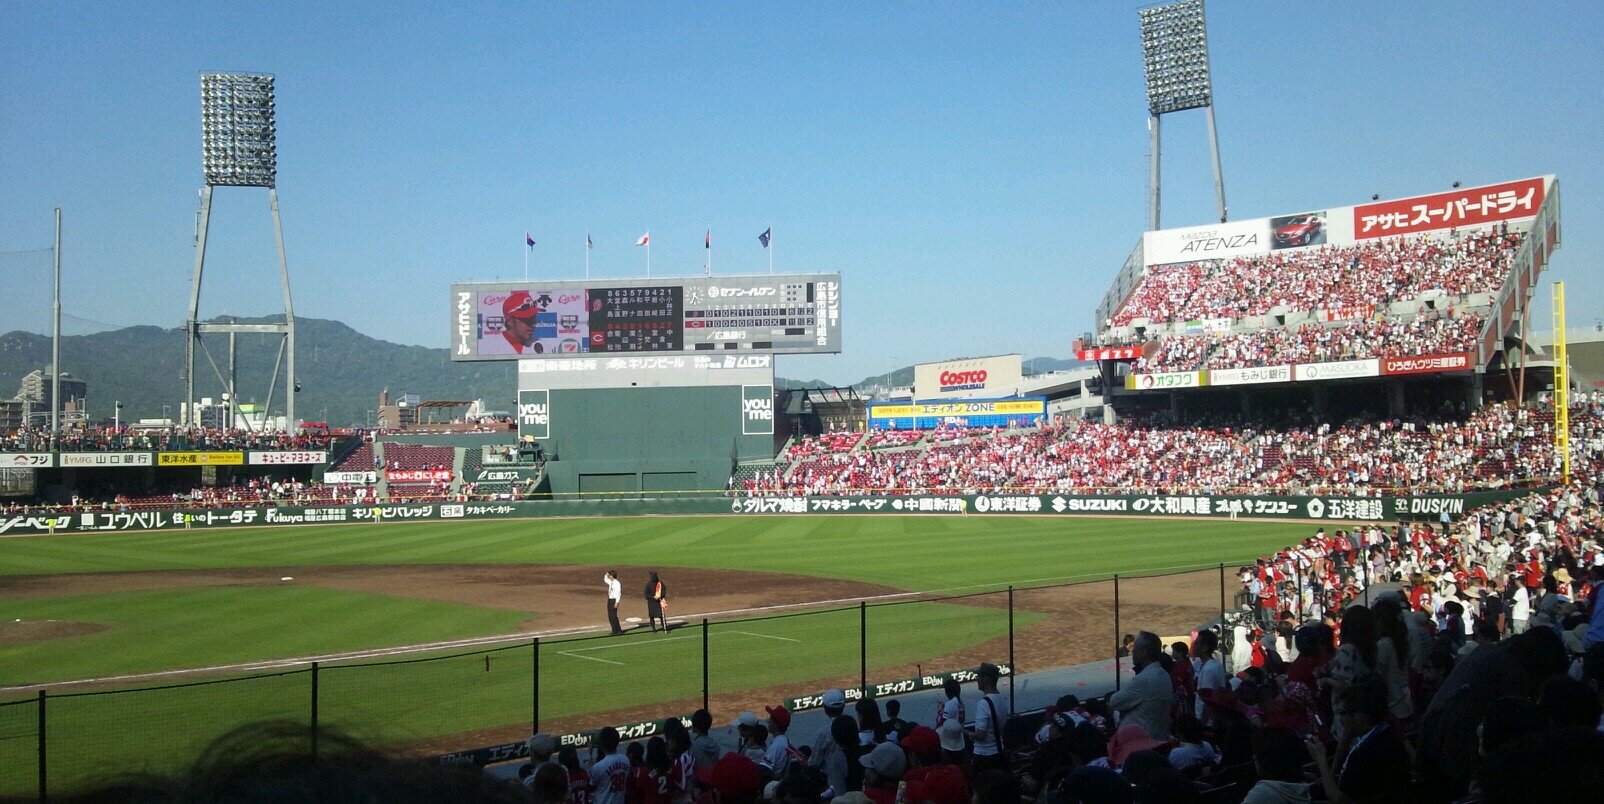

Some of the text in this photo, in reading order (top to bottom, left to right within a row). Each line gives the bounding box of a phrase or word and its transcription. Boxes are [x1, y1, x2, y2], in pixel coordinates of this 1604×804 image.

[1180, 233, 1258, 254] ATENZA
[457, 292, 470, 356] アサヒビール
[629, 358, 684, 369] キリンビール
[1320, 363, 1368, 373] MASUOKA
[940, 370, 987, 385] COSTCO
[1154, 374, 1192, 386] オタフク
[520, 404, 546, 416] you
[744, 398, 771, 412] you
[923, 404, 963, 414] エディオン
[966, 403, 995, 412] ZONE
[524, 414, 547, 425] me
[749, 408, 772, 420] me
[30, 456, 48, 465] フジ
[96, 454, 148, 465] 山口銀行
[162, 454, 197, 463] 東洋水産
[488, 472, 519, 480] 広島ガス
[466, 506, 516, 514] タカキベーカリー
[744, 497, 807, 513] ダルマ焼酎
[811, 498, 856, 511] フマキラー
[990, 497, 1042, 512] 東洋証券
[1069, 498, 1127, 511] SUZUKI
[1150, 497, 1211, 514] 大和興産
[1255, 500, 1297, 513] ケンユー
[1328, 500, 1383, 519] 五洋建設
[1411, 498, 1464, 513] DUSKIN
[99, 512, 166, 530] ユウベル
[172, 510, 258, 525] 住いのトータテ
[265, 508, 303, 524] Fukuya
[876, 680, 915, 696] エディオン
[615, 722, 656, 739] ディオン
